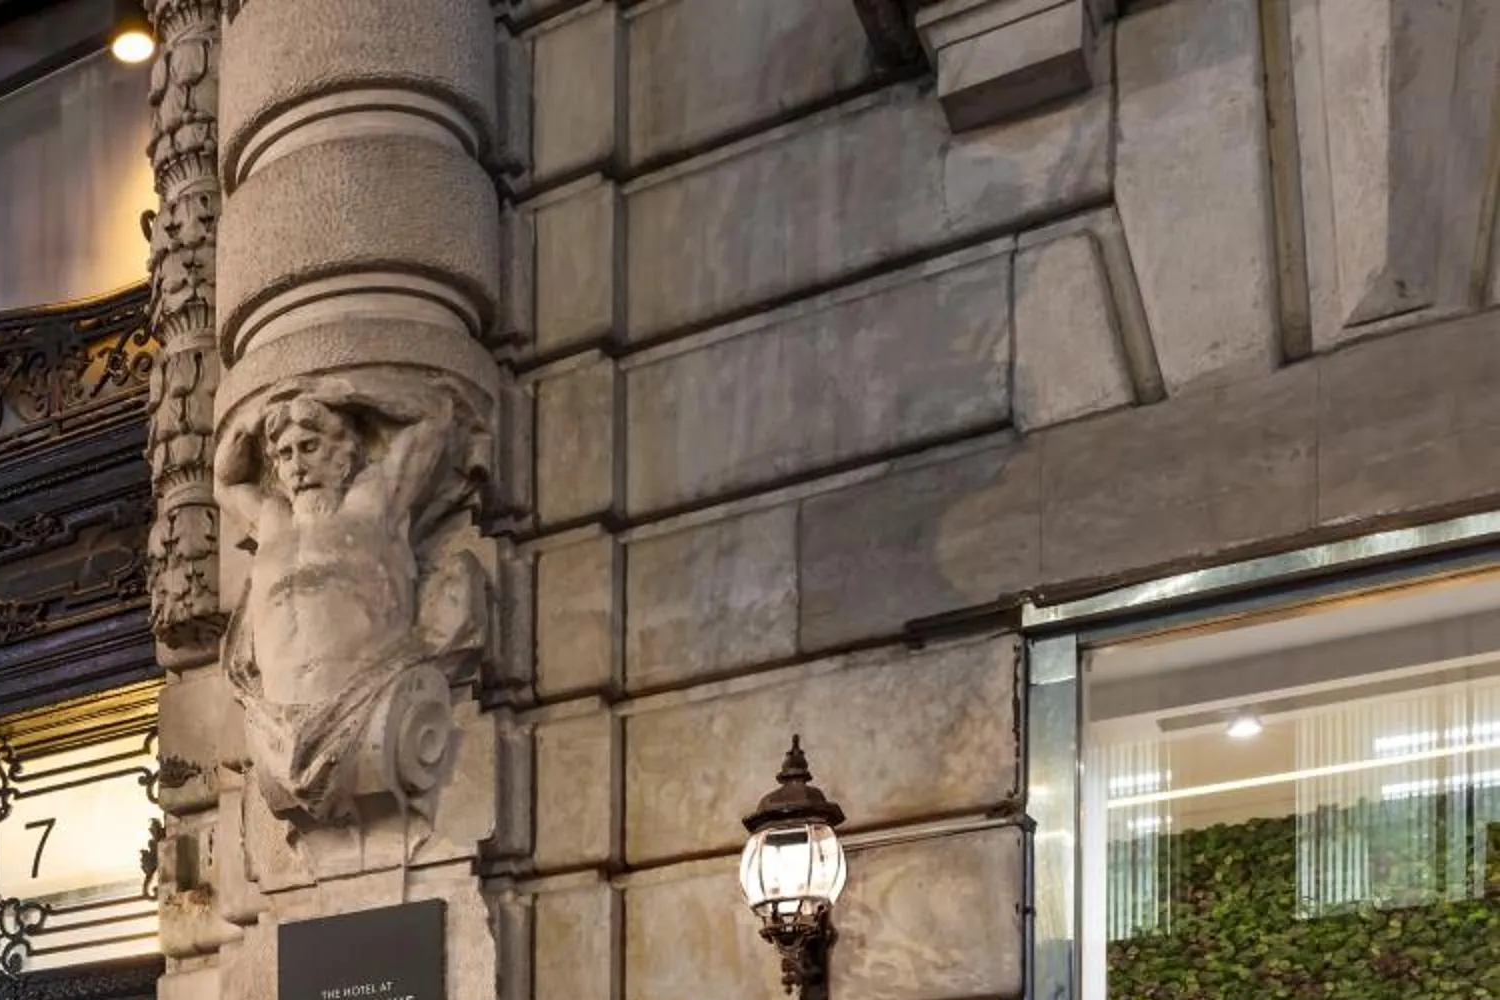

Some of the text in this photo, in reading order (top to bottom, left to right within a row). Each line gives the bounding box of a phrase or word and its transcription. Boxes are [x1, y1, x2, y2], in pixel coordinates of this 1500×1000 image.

[321, 980, 393, 1000] THE HOTEL AT
